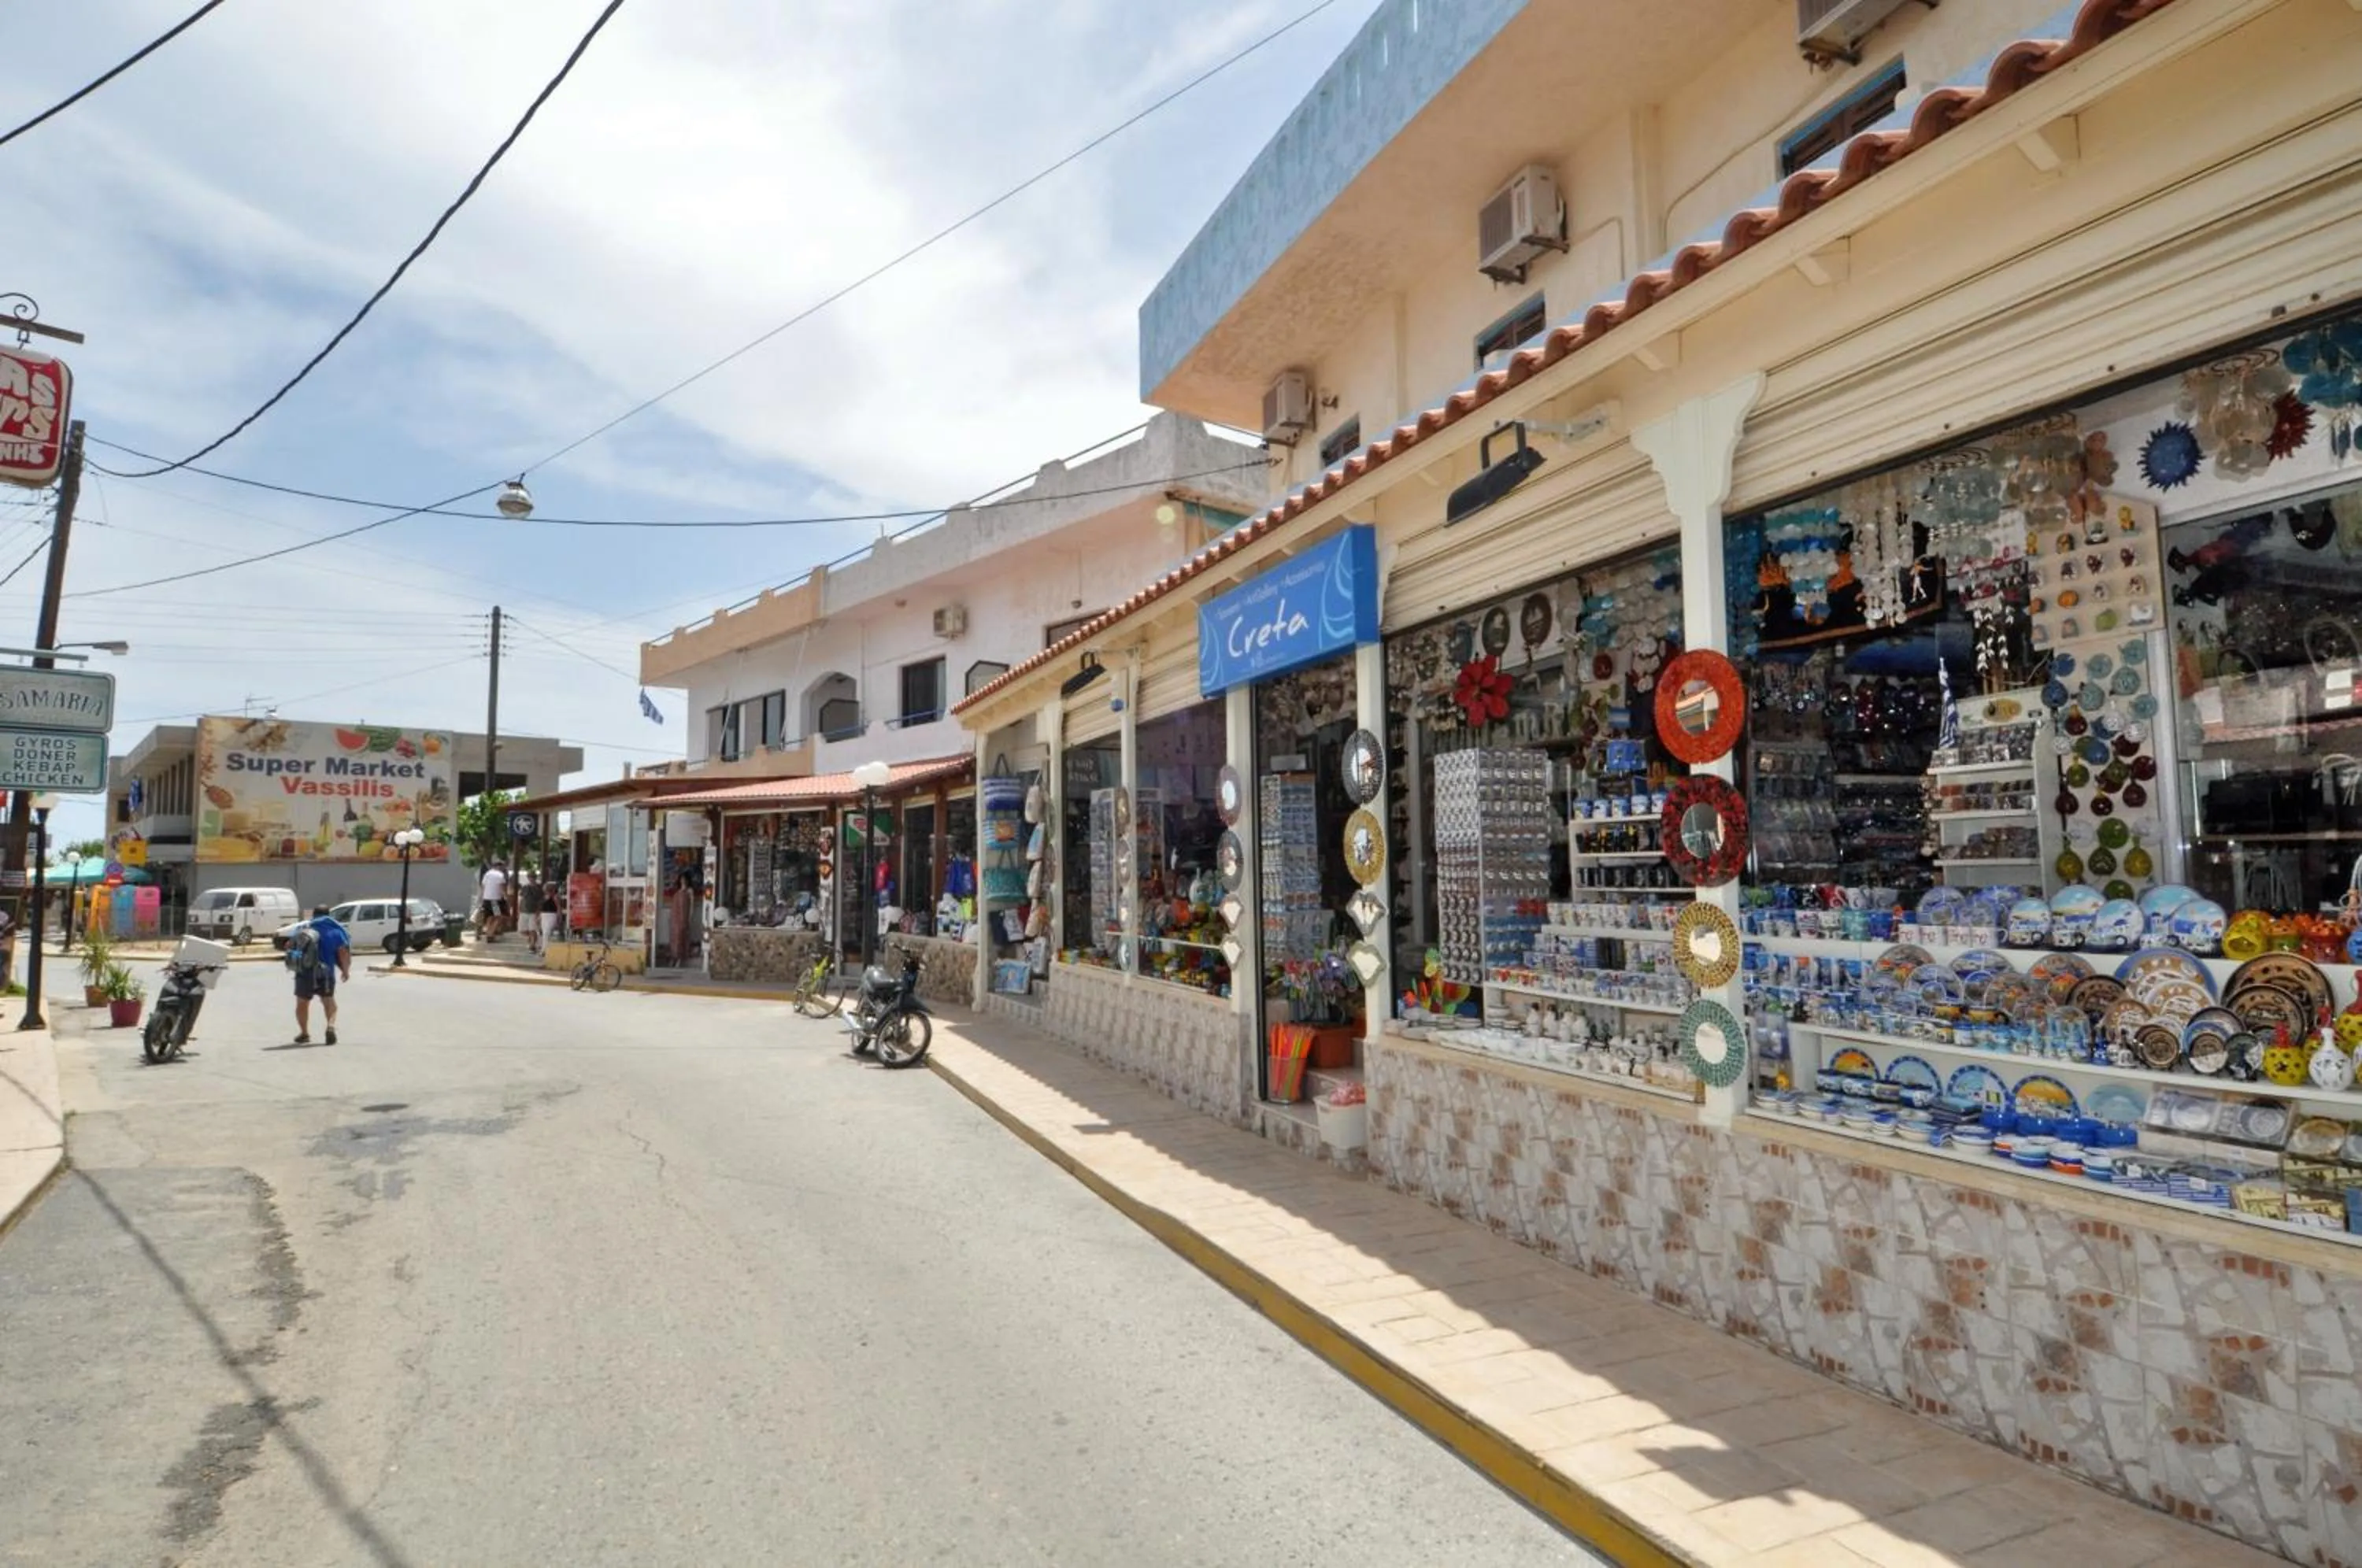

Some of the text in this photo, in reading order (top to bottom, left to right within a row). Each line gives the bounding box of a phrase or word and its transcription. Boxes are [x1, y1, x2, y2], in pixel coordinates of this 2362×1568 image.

[1229, 597, 1309, 658] Creta
[0, 689, 103, 716] SAMARIA
[15, 736, 76, 749] GYROS
[13, 749, 76, 761] DONER
[13, 760, 76, 772] KEBAP
[227, 753, 425, 778] Super Market
[2, 772, 84, 785] CHICKEN
[280, 776, 394, 797] Vassilis
